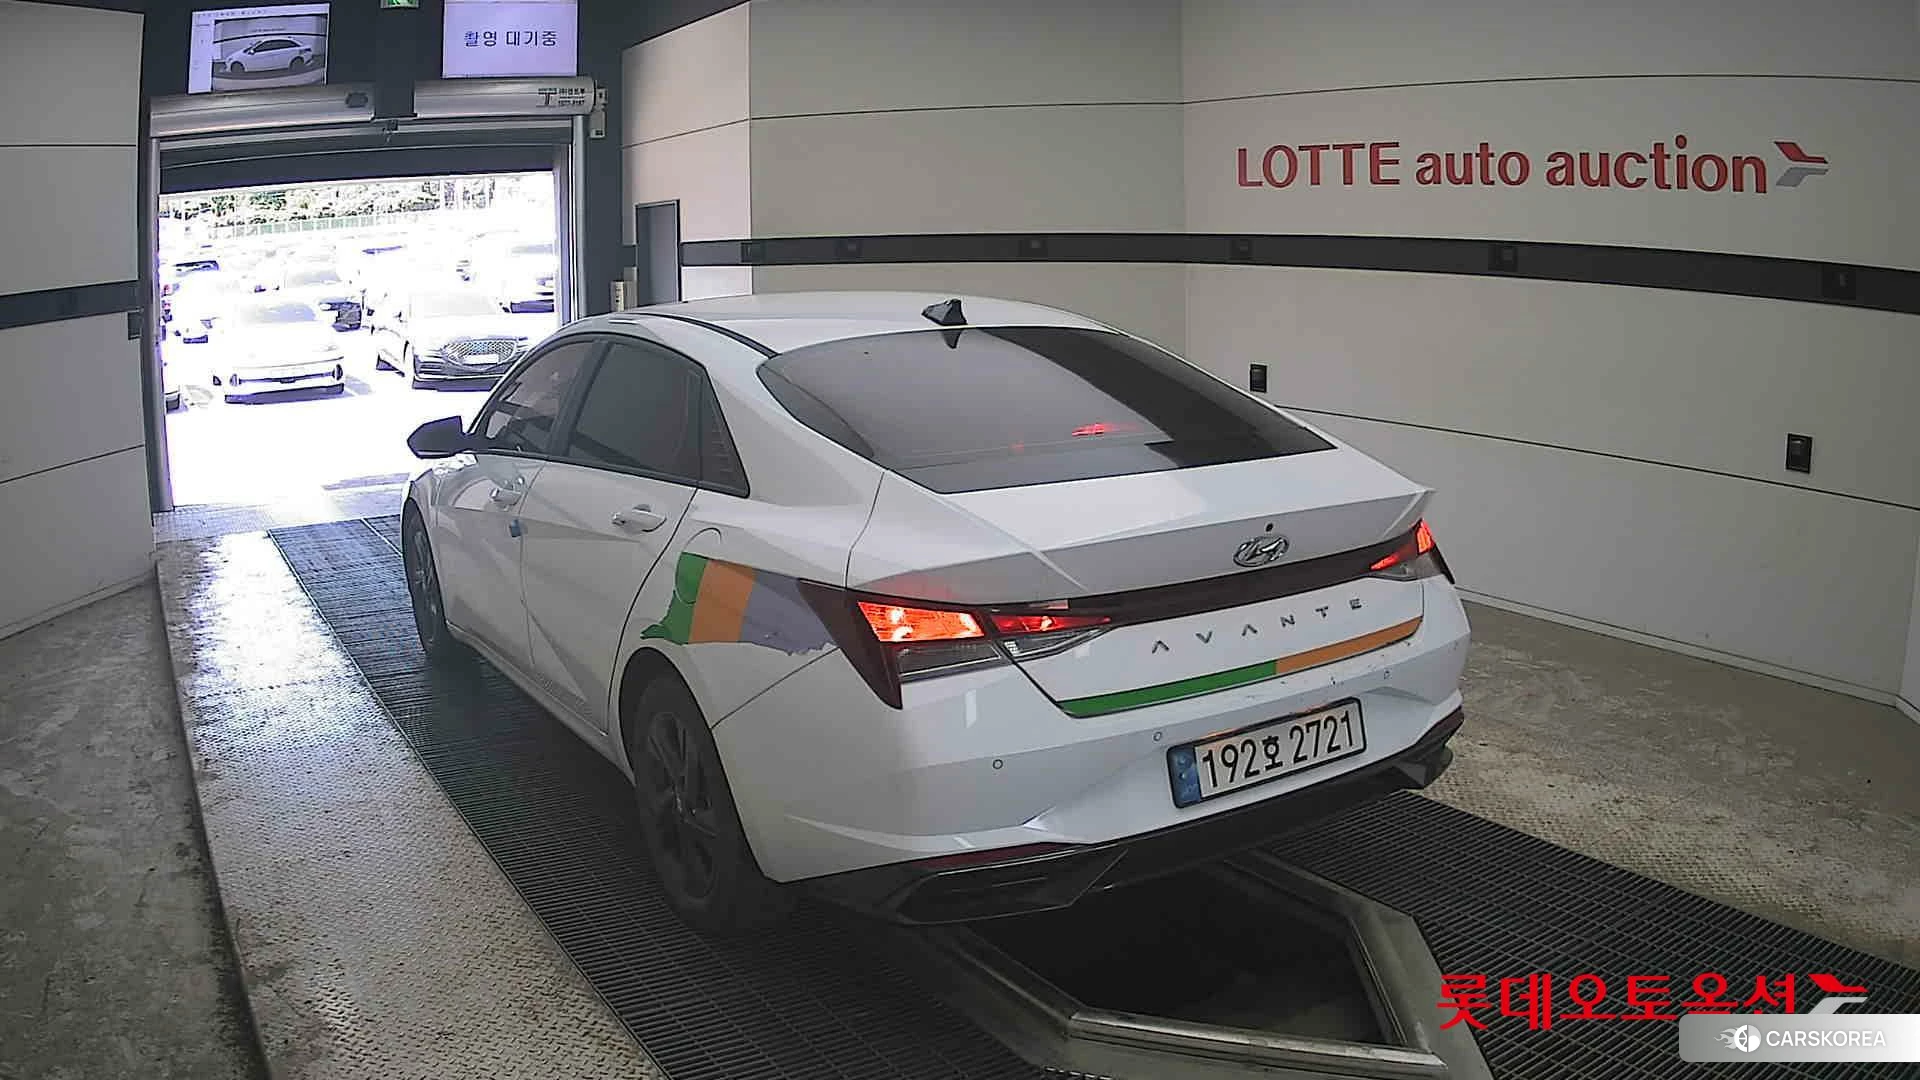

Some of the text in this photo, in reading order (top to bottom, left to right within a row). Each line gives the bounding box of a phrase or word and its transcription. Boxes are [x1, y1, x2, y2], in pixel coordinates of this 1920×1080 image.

[506, 31, 557, 47] 대기중
[1238, 135, 1767, 193] LOTTE auto auction
[1151, 597, 1363, 655] AVANTE
[1201, 709, 1354, 789] 192호 2721
